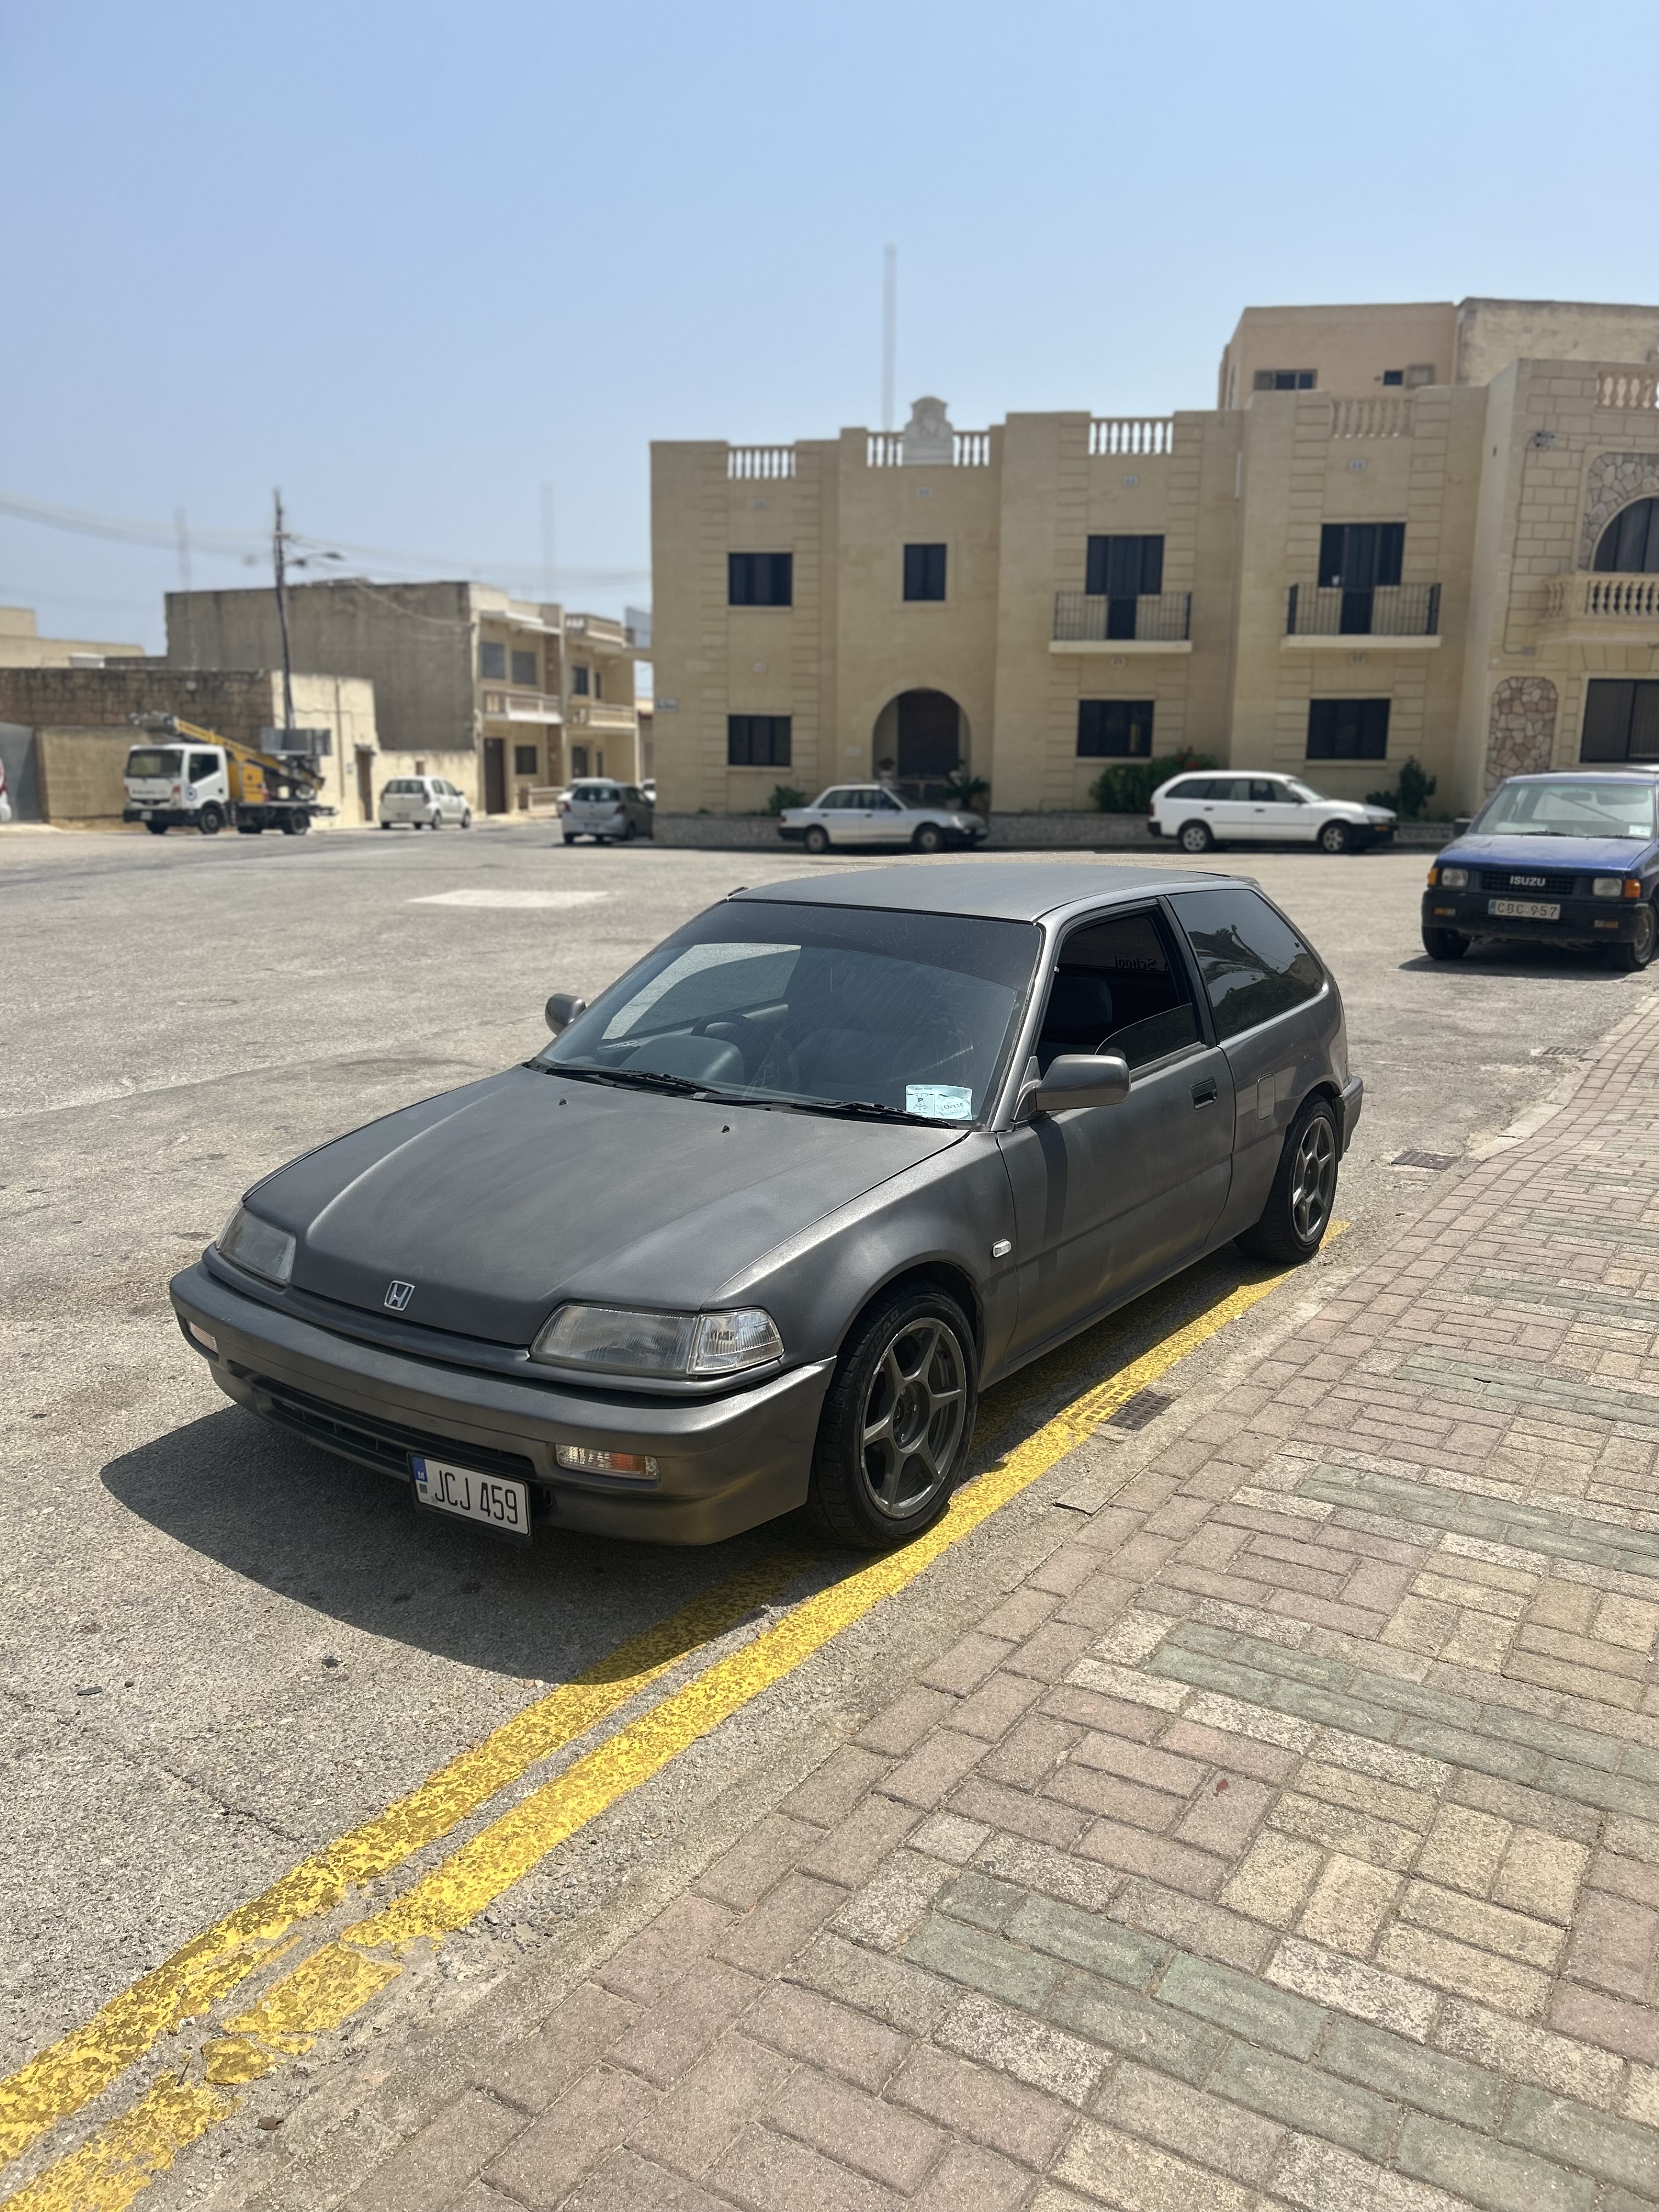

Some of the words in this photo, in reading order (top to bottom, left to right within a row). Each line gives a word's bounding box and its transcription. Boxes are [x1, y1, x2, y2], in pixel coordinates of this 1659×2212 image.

[1510, 876, 1545, 887] ISUZU
[1497, 902, 1524, 915] CBC
[1531, 905, 1558, 917] 957
[417, 1471, 425, 1481] M
[435, 1470, 471, 1510] JCJ
[480, 1482, 518, 1525] 459
